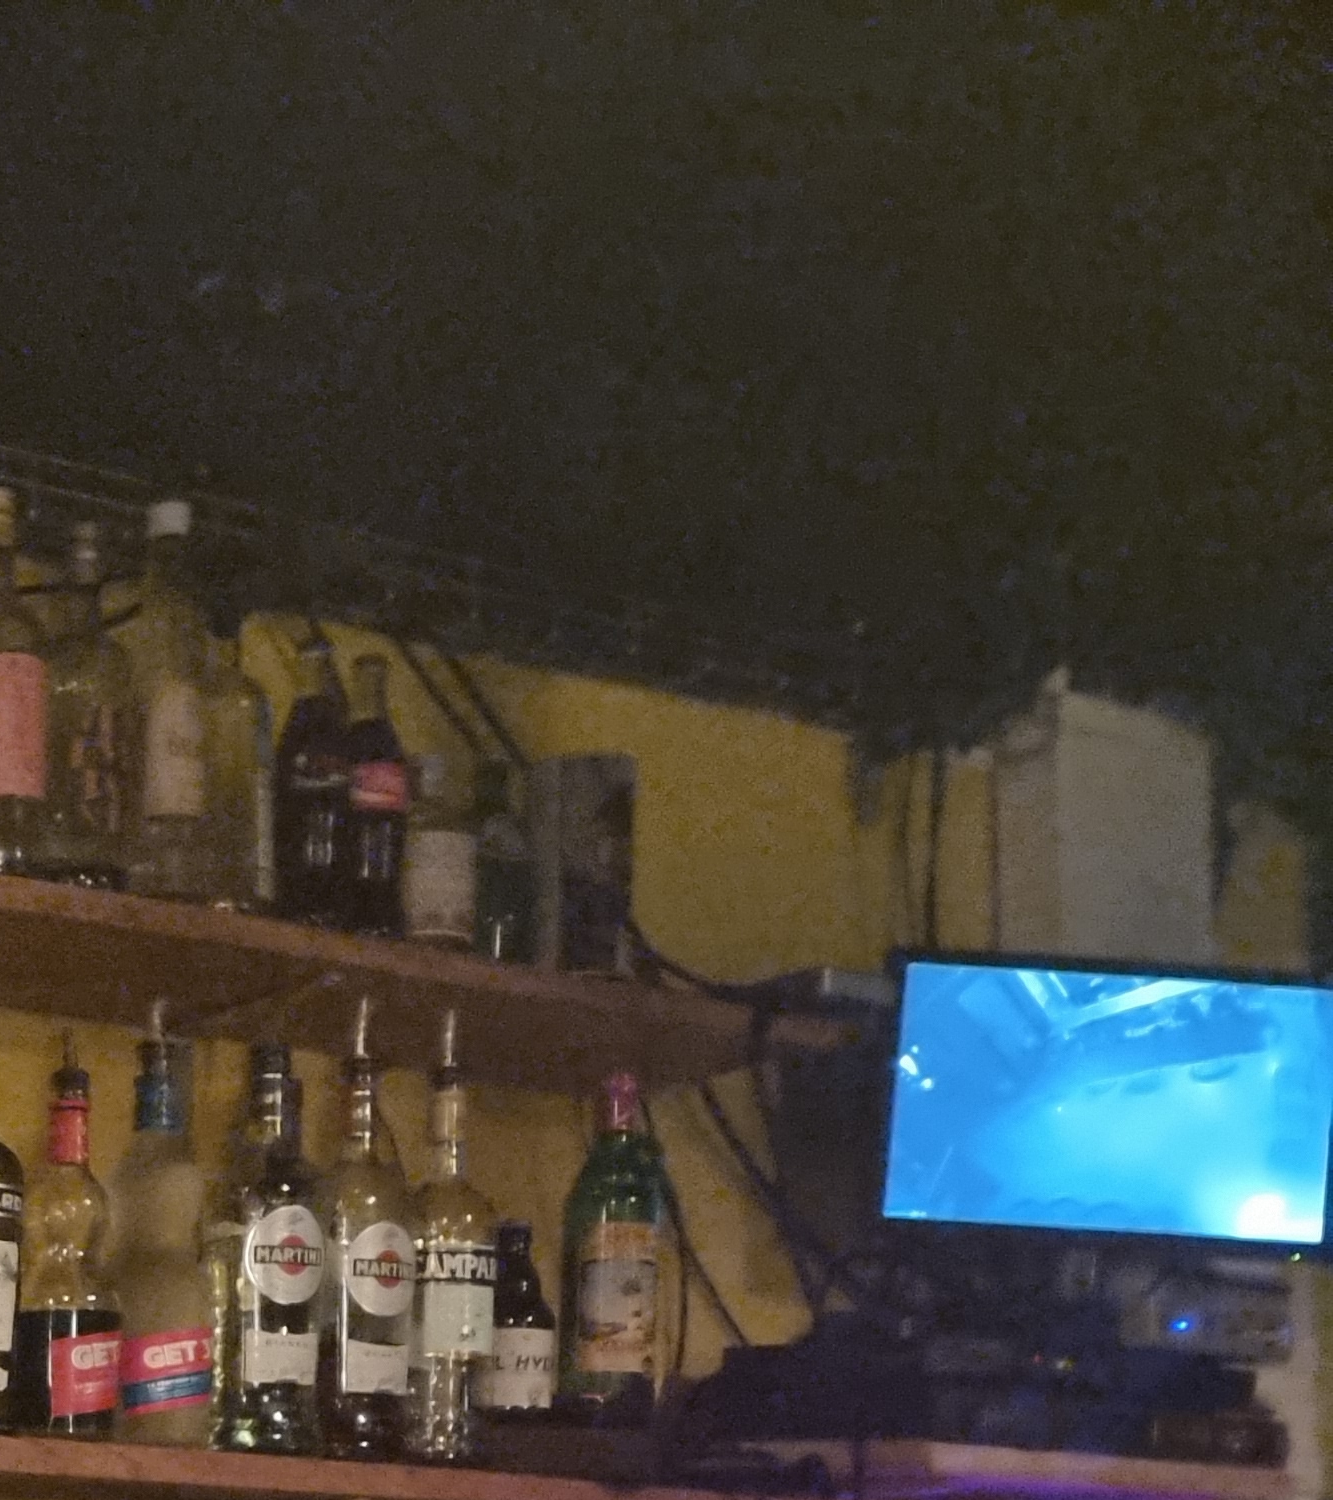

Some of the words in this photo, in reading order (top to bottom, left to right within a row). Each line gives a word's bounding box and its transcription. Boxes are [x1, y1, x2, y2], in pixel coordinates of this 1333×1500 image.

[255, 1246, 321, 1266] MARTINI
[71, 1340, 120, 1370] GET
[143, 1340, 198, 1369] GET
